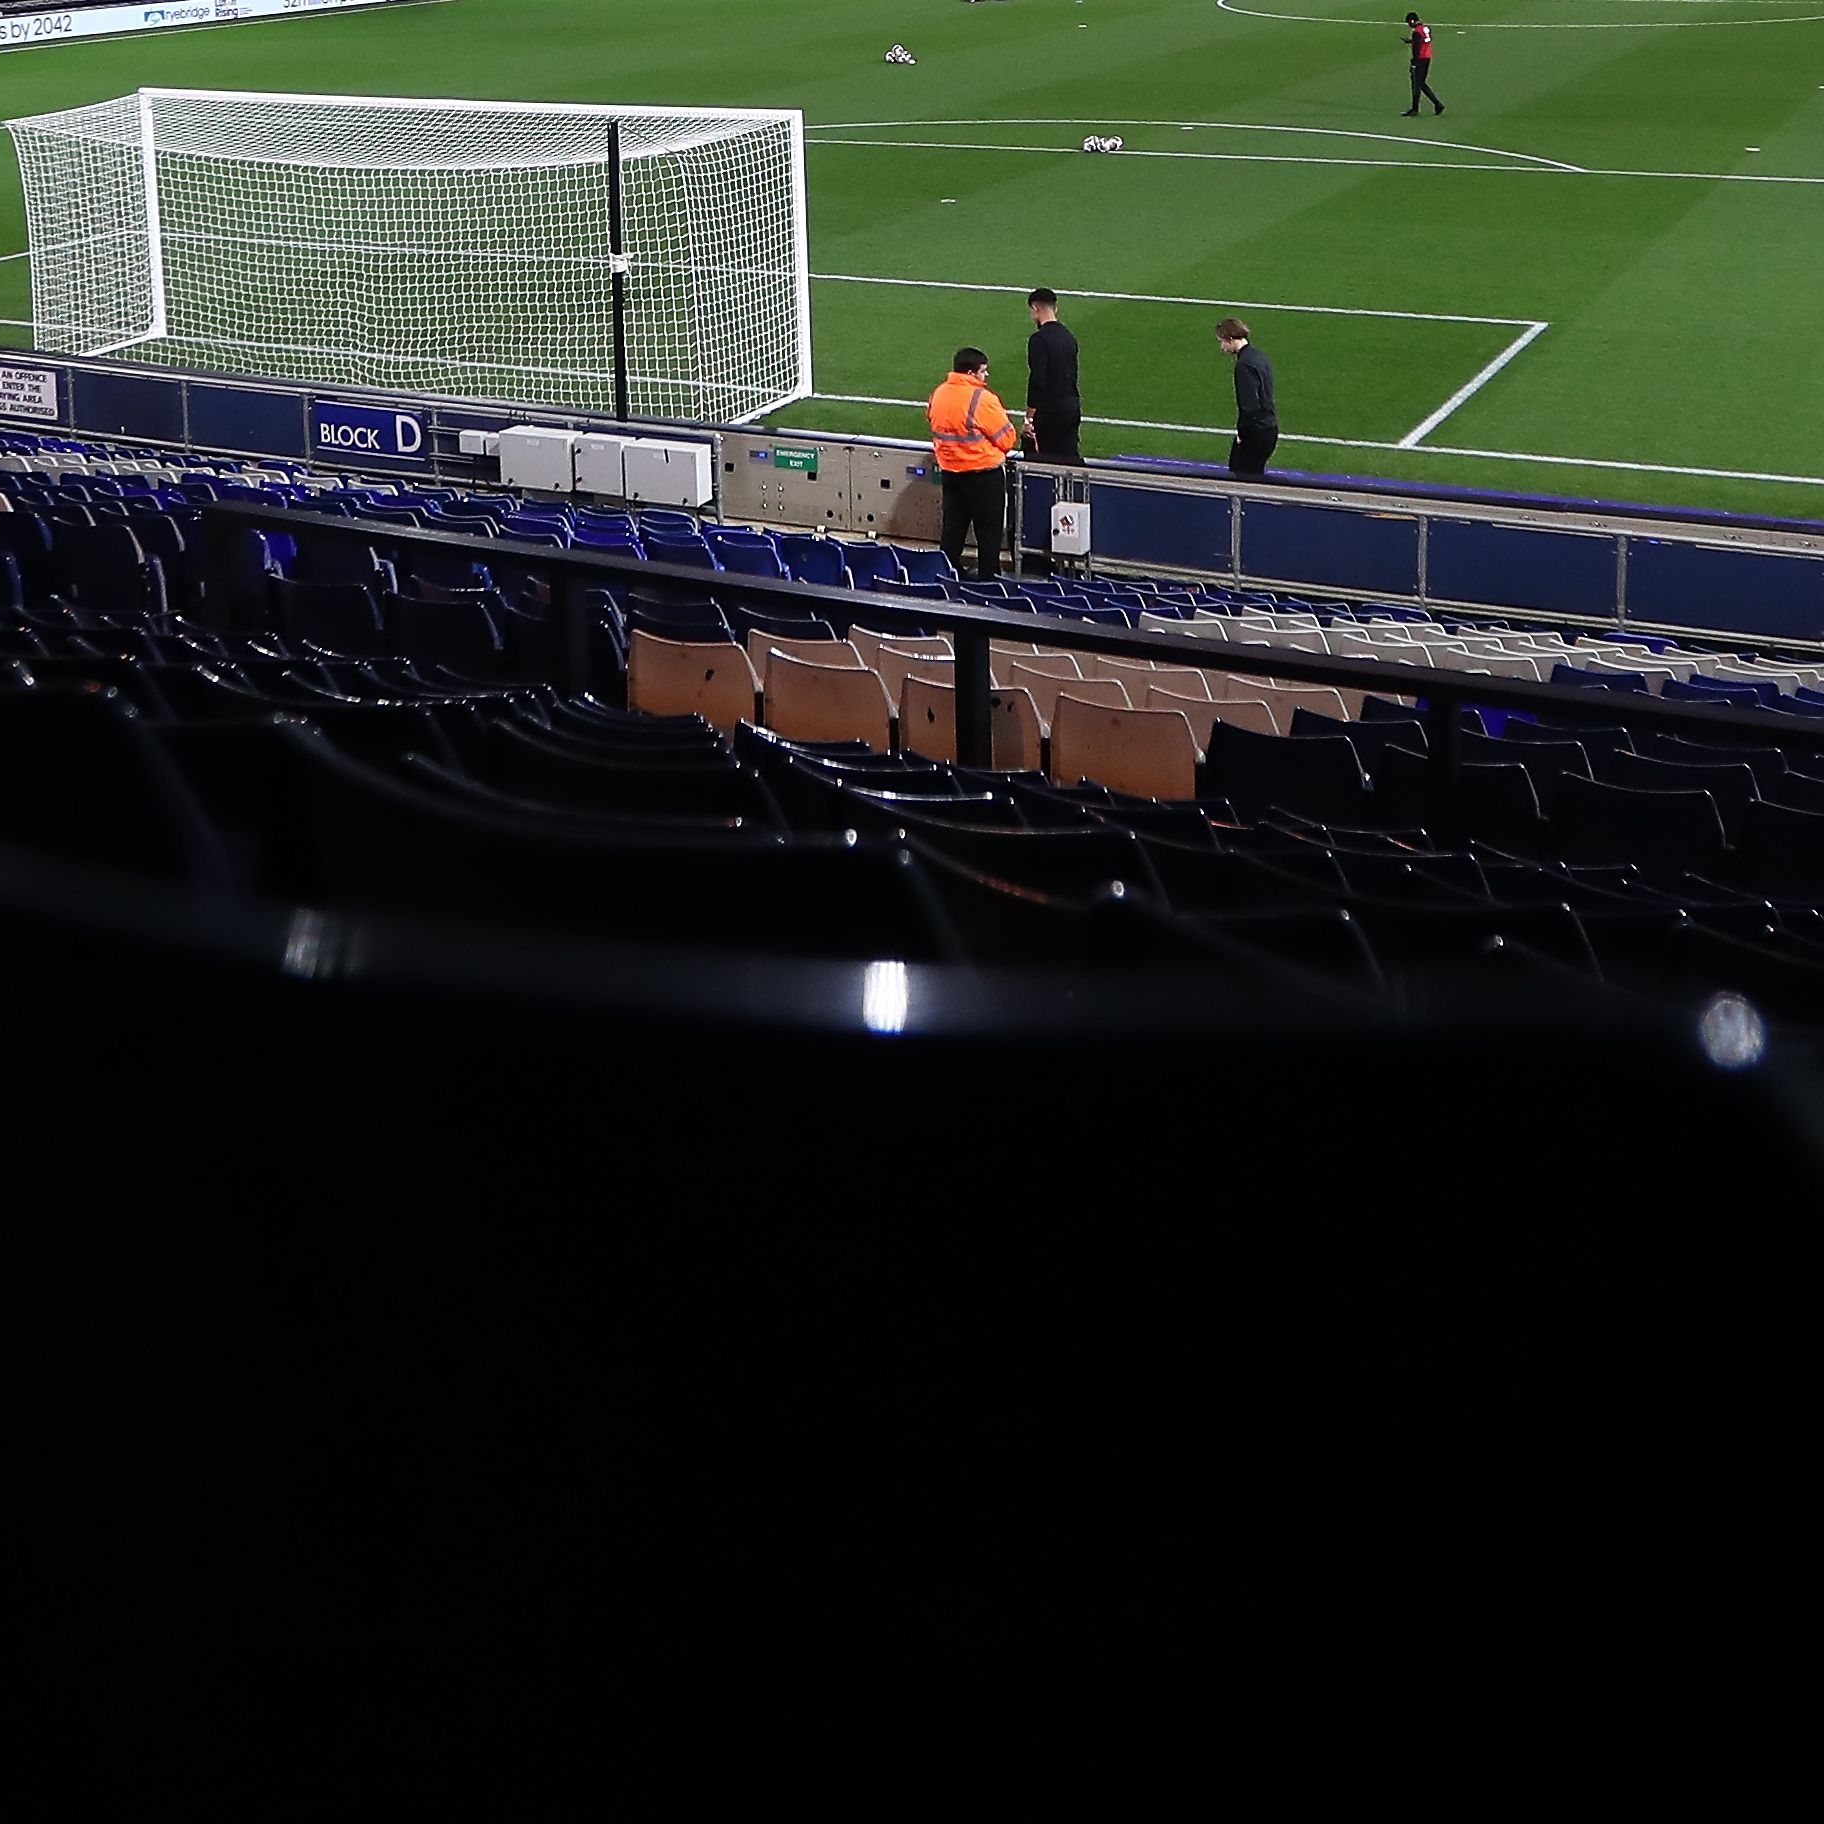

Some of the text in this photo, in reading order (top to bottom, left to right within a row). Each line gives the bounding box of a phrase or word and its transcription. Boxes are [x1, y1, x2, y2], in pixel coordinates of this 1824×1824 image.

[165, 6, 209, 20] ryebridge
[215, 7, 239, 19] Rising
[11, 20, 31, 42] by
[33, 15, 73, 36] 2042
[1, 370, 13, 379] AN
[15, 371, 47, 383] OFFENCE
[2, 381, 25, 391] ENTER
[27, 383, 41, 393] THE
[22, 394, 42, 404] AREA
[320, 414, 422, 453] BLOCK D
[776, 449, 815, 459] EMERGENCY
[789, 460, 804, 468] EXIT
